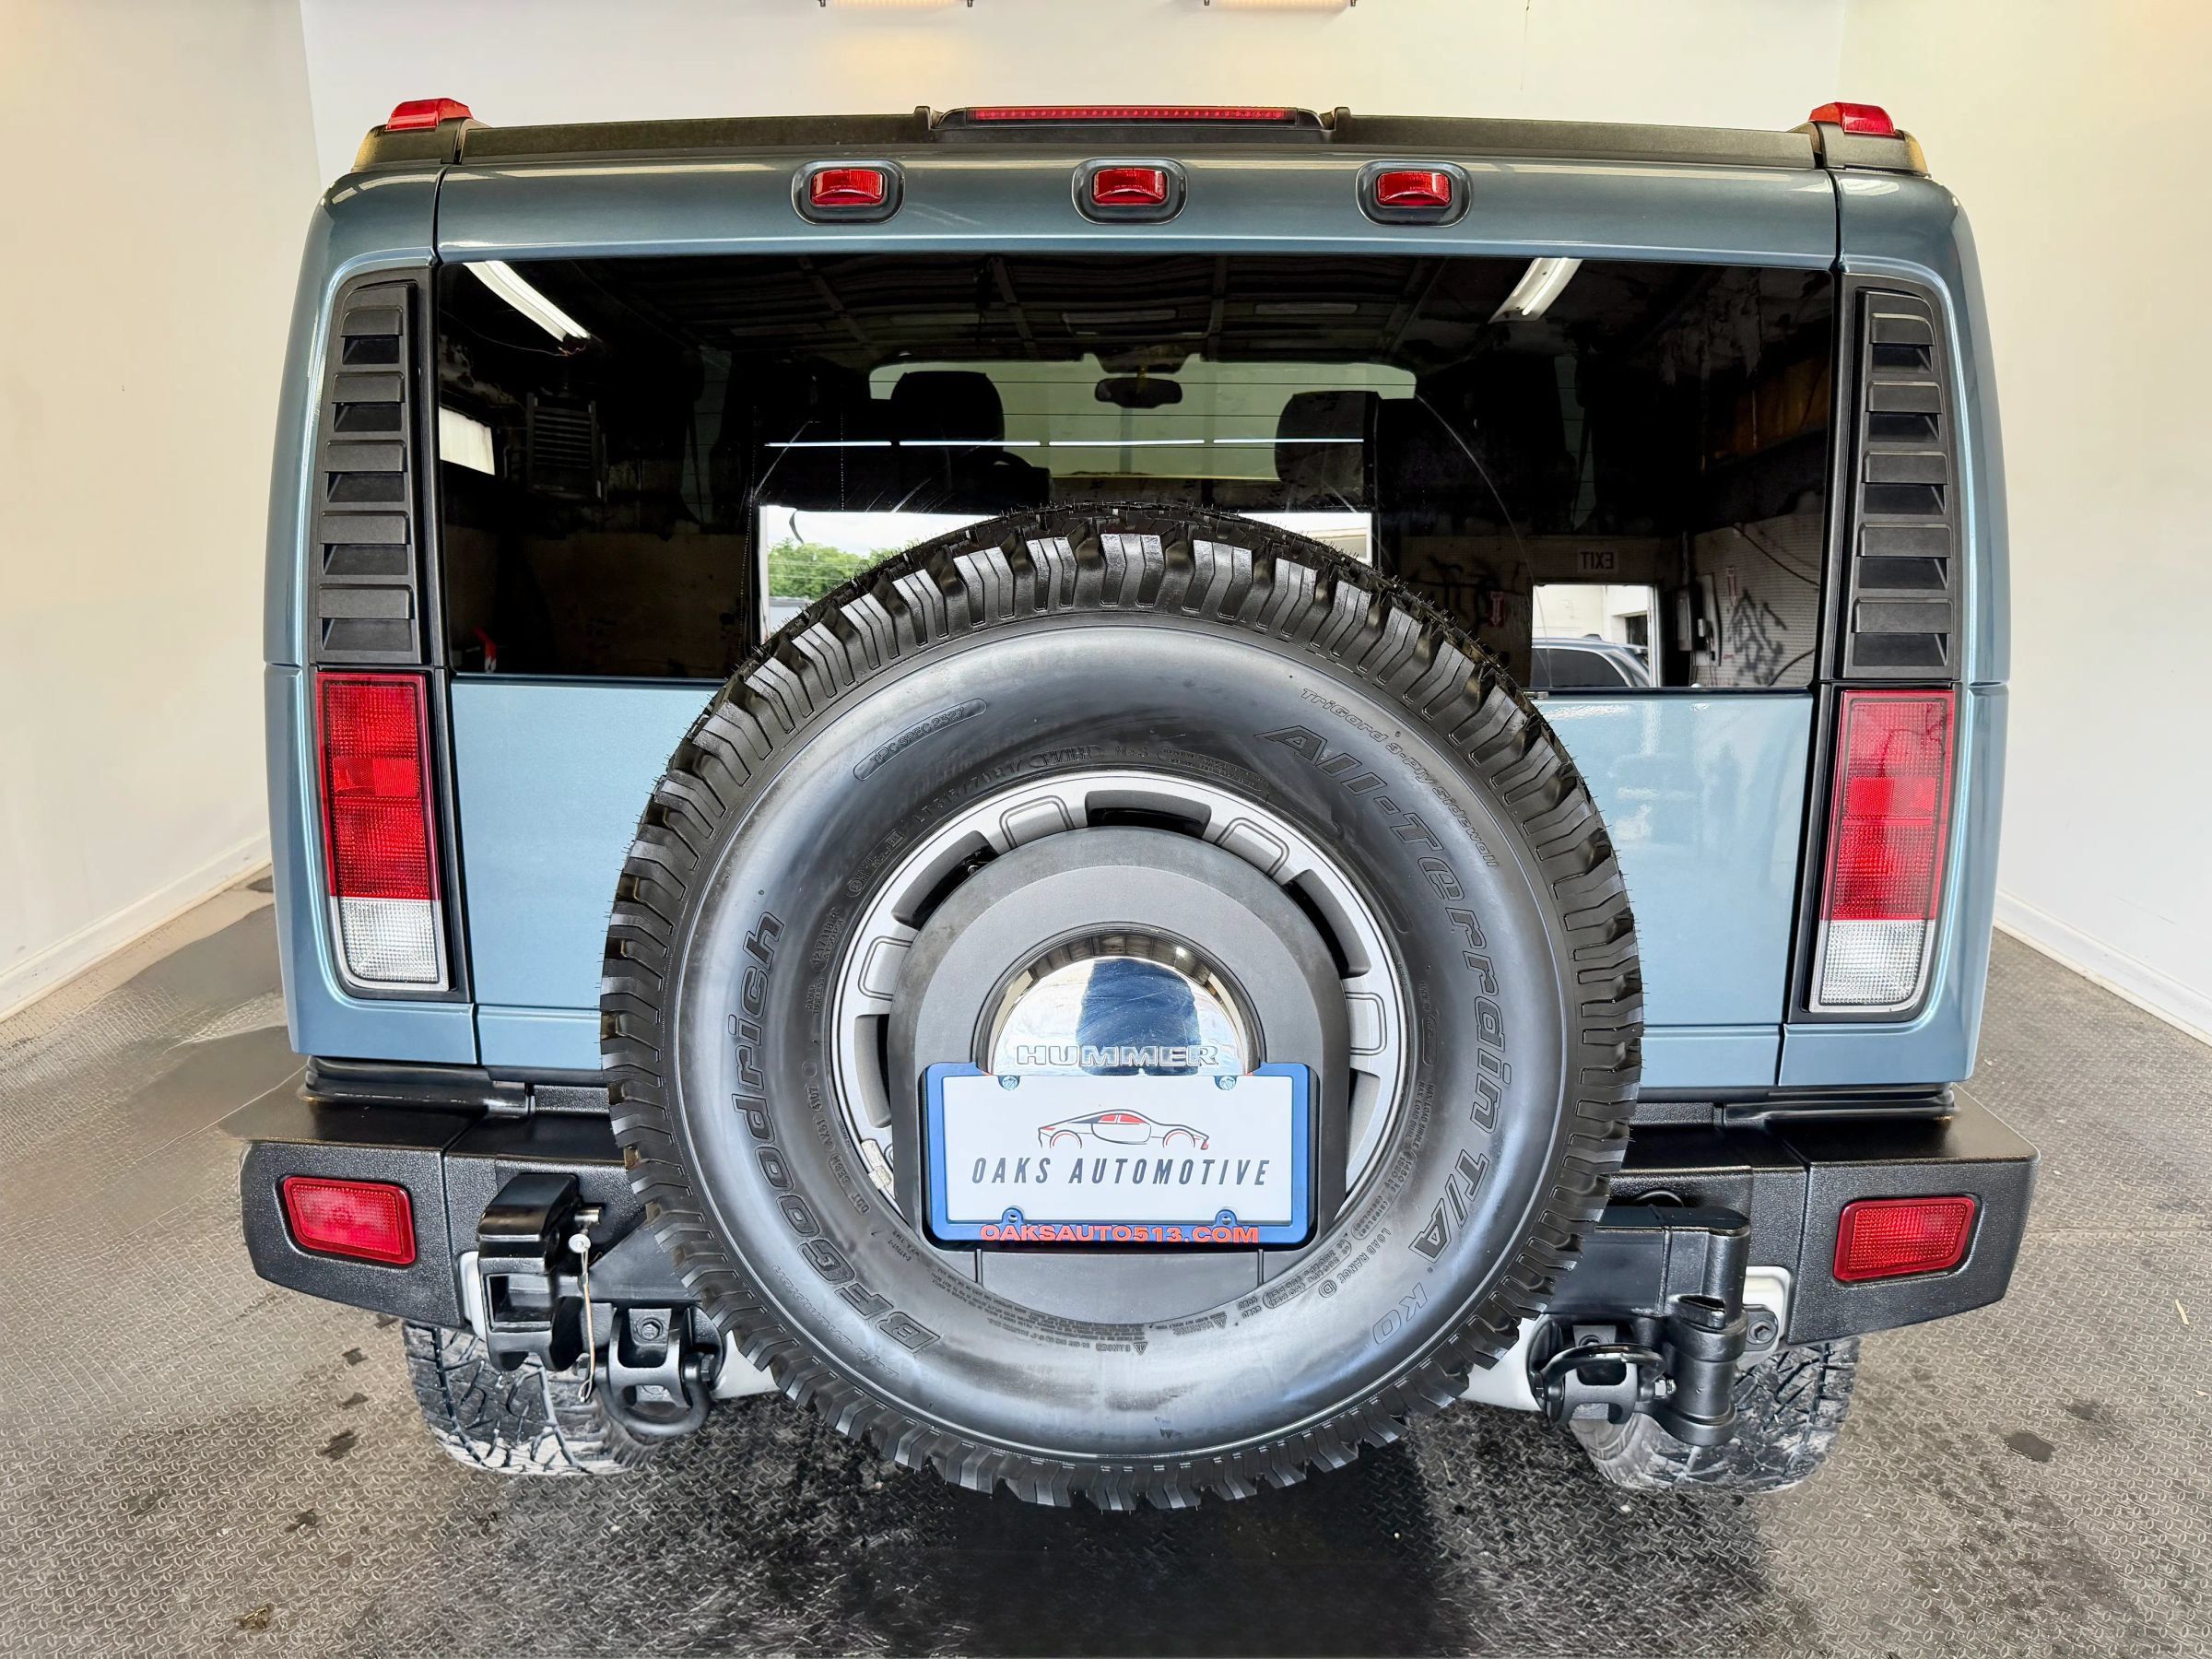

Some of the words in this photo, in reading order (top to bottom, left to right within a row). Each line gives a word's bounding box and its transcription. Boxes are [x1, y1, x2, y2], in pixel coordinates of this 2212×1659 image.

[1300, 688, 1389, 743] TriGard
[1385, 741, 1437, 785] 3-Ply
[1431, 785, 1500, 868] Sidewall
[1253, 724, 1512, 1135] All-Terrain
[1016, 1044, 1219, 1066] HUMMER
[1410, 1099, 1422, 1120] LOAD
[1419, 1101, 1430, 1123] LOAD
[727, 911, 941, 1354] BFGoodrich
[1410, 1122, 1426, 1149] SINGLE
[971, 1157, 1052, 1185] OAKS
[1069, 1159, 1271, 1186] AUTOMOTIVE
[1408, 1148, 1490, 1265] T/A
[979, 1224, 1260, 1244] OAKSAUTO513.COM
[1364, 1226, 1392, 1256] LOAD
[1335, 1251, 1370, 1284] RANGE
[1372, 1282, 1430, 1345] KO
